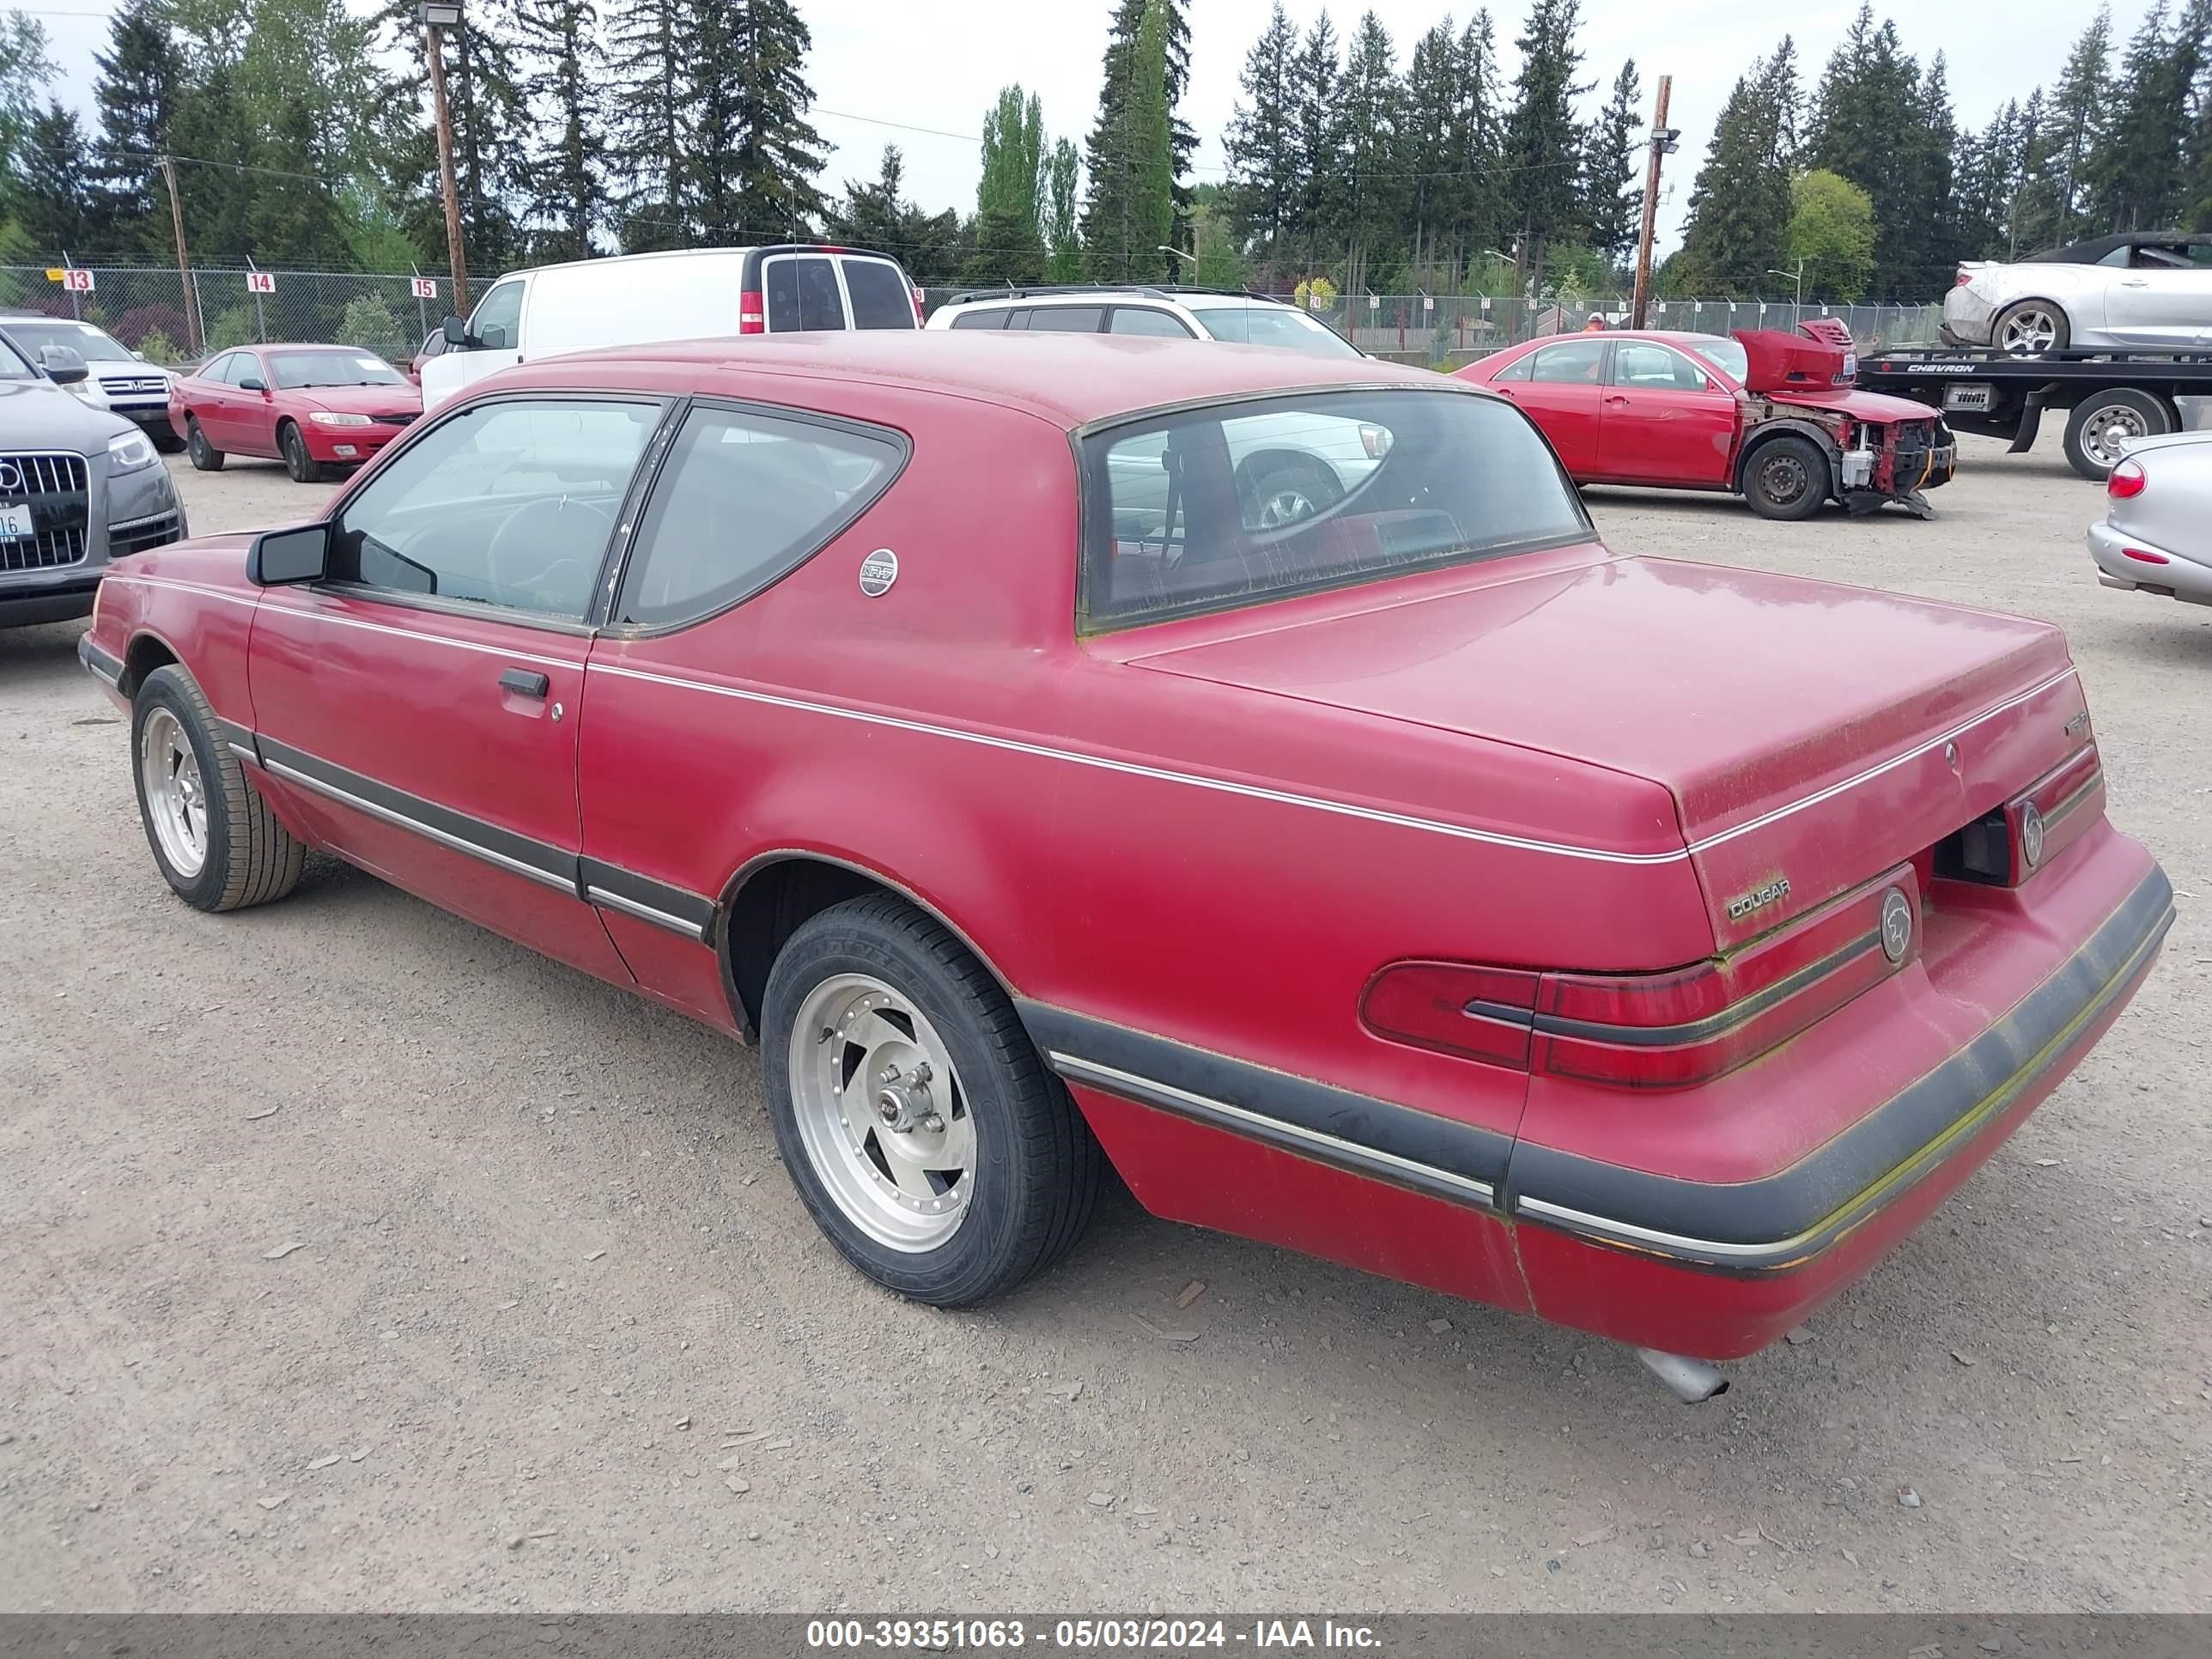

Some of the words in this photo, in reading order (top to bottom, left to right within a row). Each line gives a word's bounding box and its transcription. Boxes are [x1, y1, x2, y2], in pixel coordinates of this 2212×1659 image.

[68, 271, 89, 289] 13
[252, 274, 270, 291] 14
[416, 280, 432, 296] 15
[1310, 298, 1320, 307] 24
[1370, 298, 1378, 307] 25
[1425, 300, 1432, 308] 26
[1482, 299, 1490, 308] 27
[861, 564, 894, 579] XR-7
[1730, 879, 1791, 917] COUGAR
